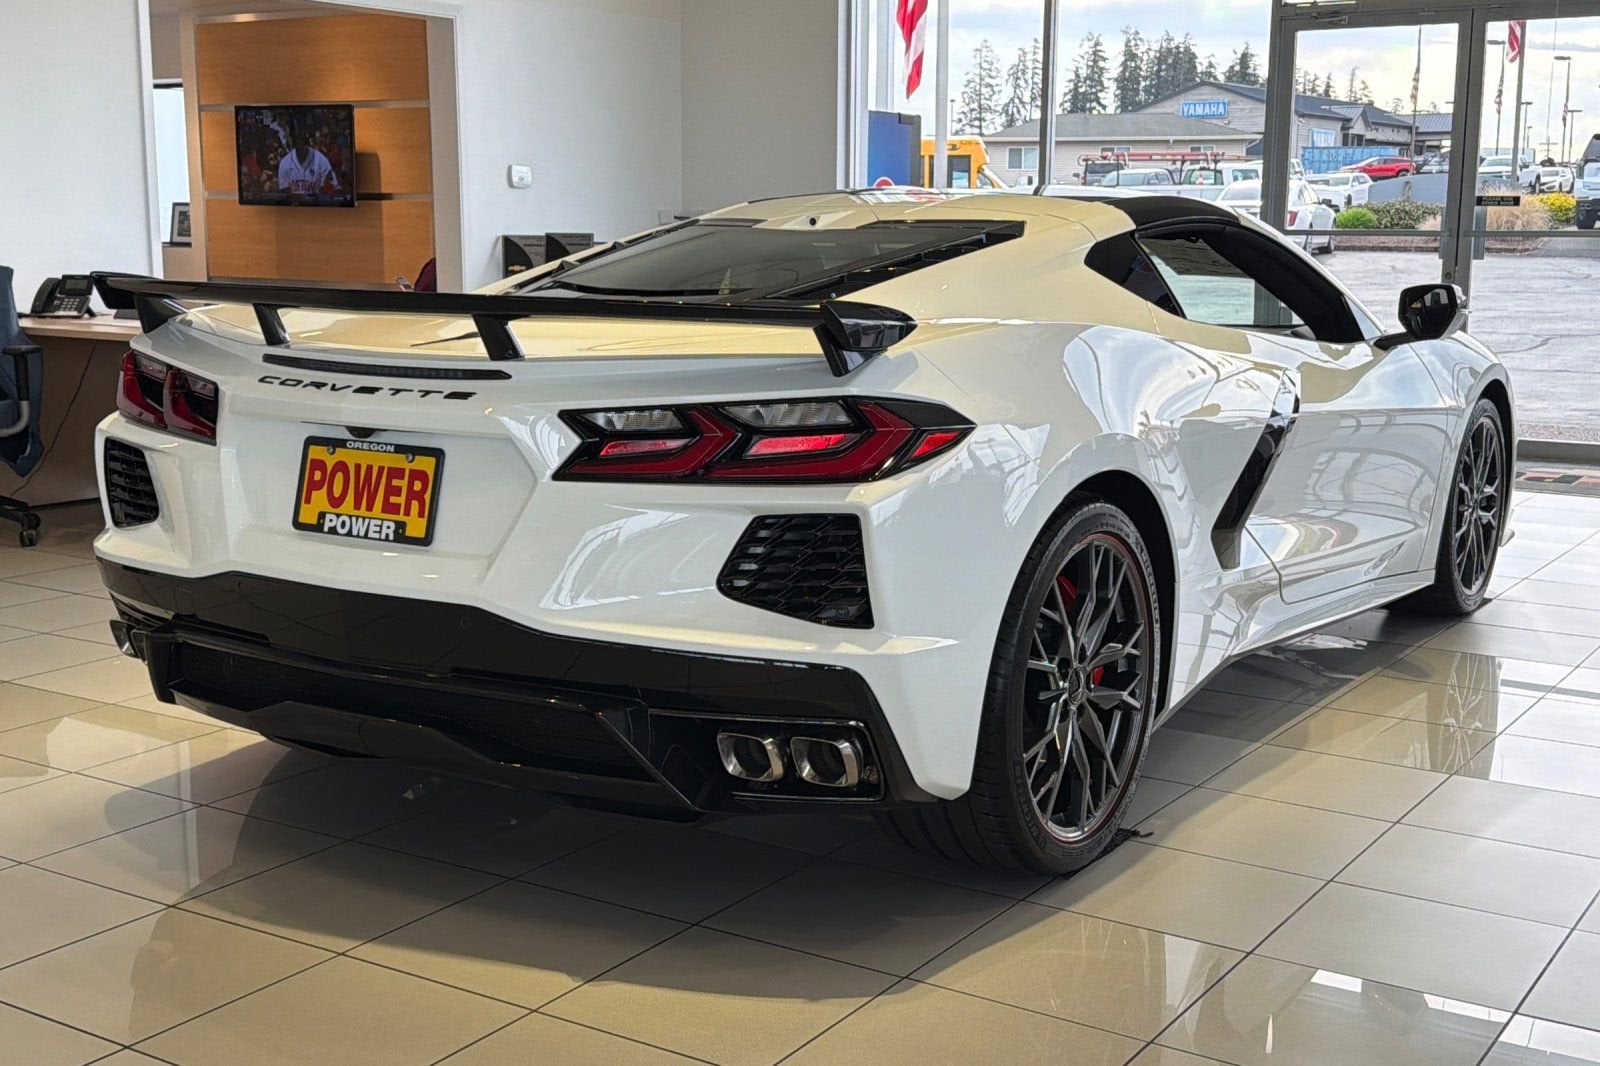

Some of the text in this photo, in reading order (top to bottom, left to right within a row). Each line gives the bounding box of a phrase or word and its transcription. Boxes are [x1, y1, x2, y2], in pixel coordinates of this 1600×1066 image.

[1183, 103, 1225, 116] YAMAHA
[257, 375, 478, 400] CORVETTE
[346, 440, 395, 453] OREGON
[303, 458, 430, 519] POWER
[323, 513, 396, 541] POWER
